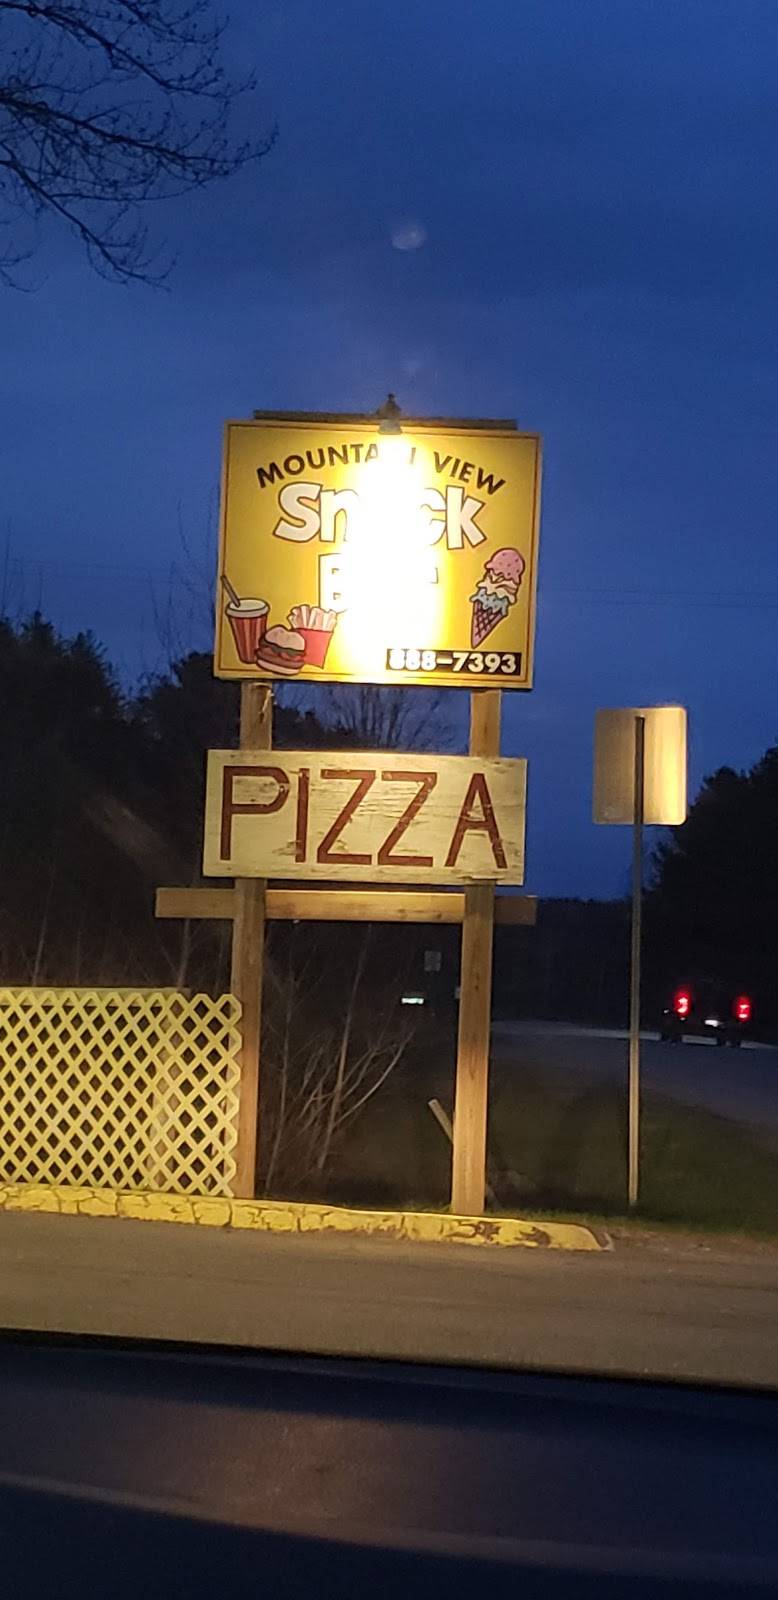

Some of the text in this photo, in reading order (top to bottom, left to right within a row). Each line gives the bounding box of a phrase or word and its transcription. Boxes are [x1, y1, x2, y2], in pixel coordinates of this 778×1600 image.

[256, 443, 506, 495] MOUNTA VIEW
[272, 481, 487, 550] Snck
[220, 765, 508, 869] PIZZA
